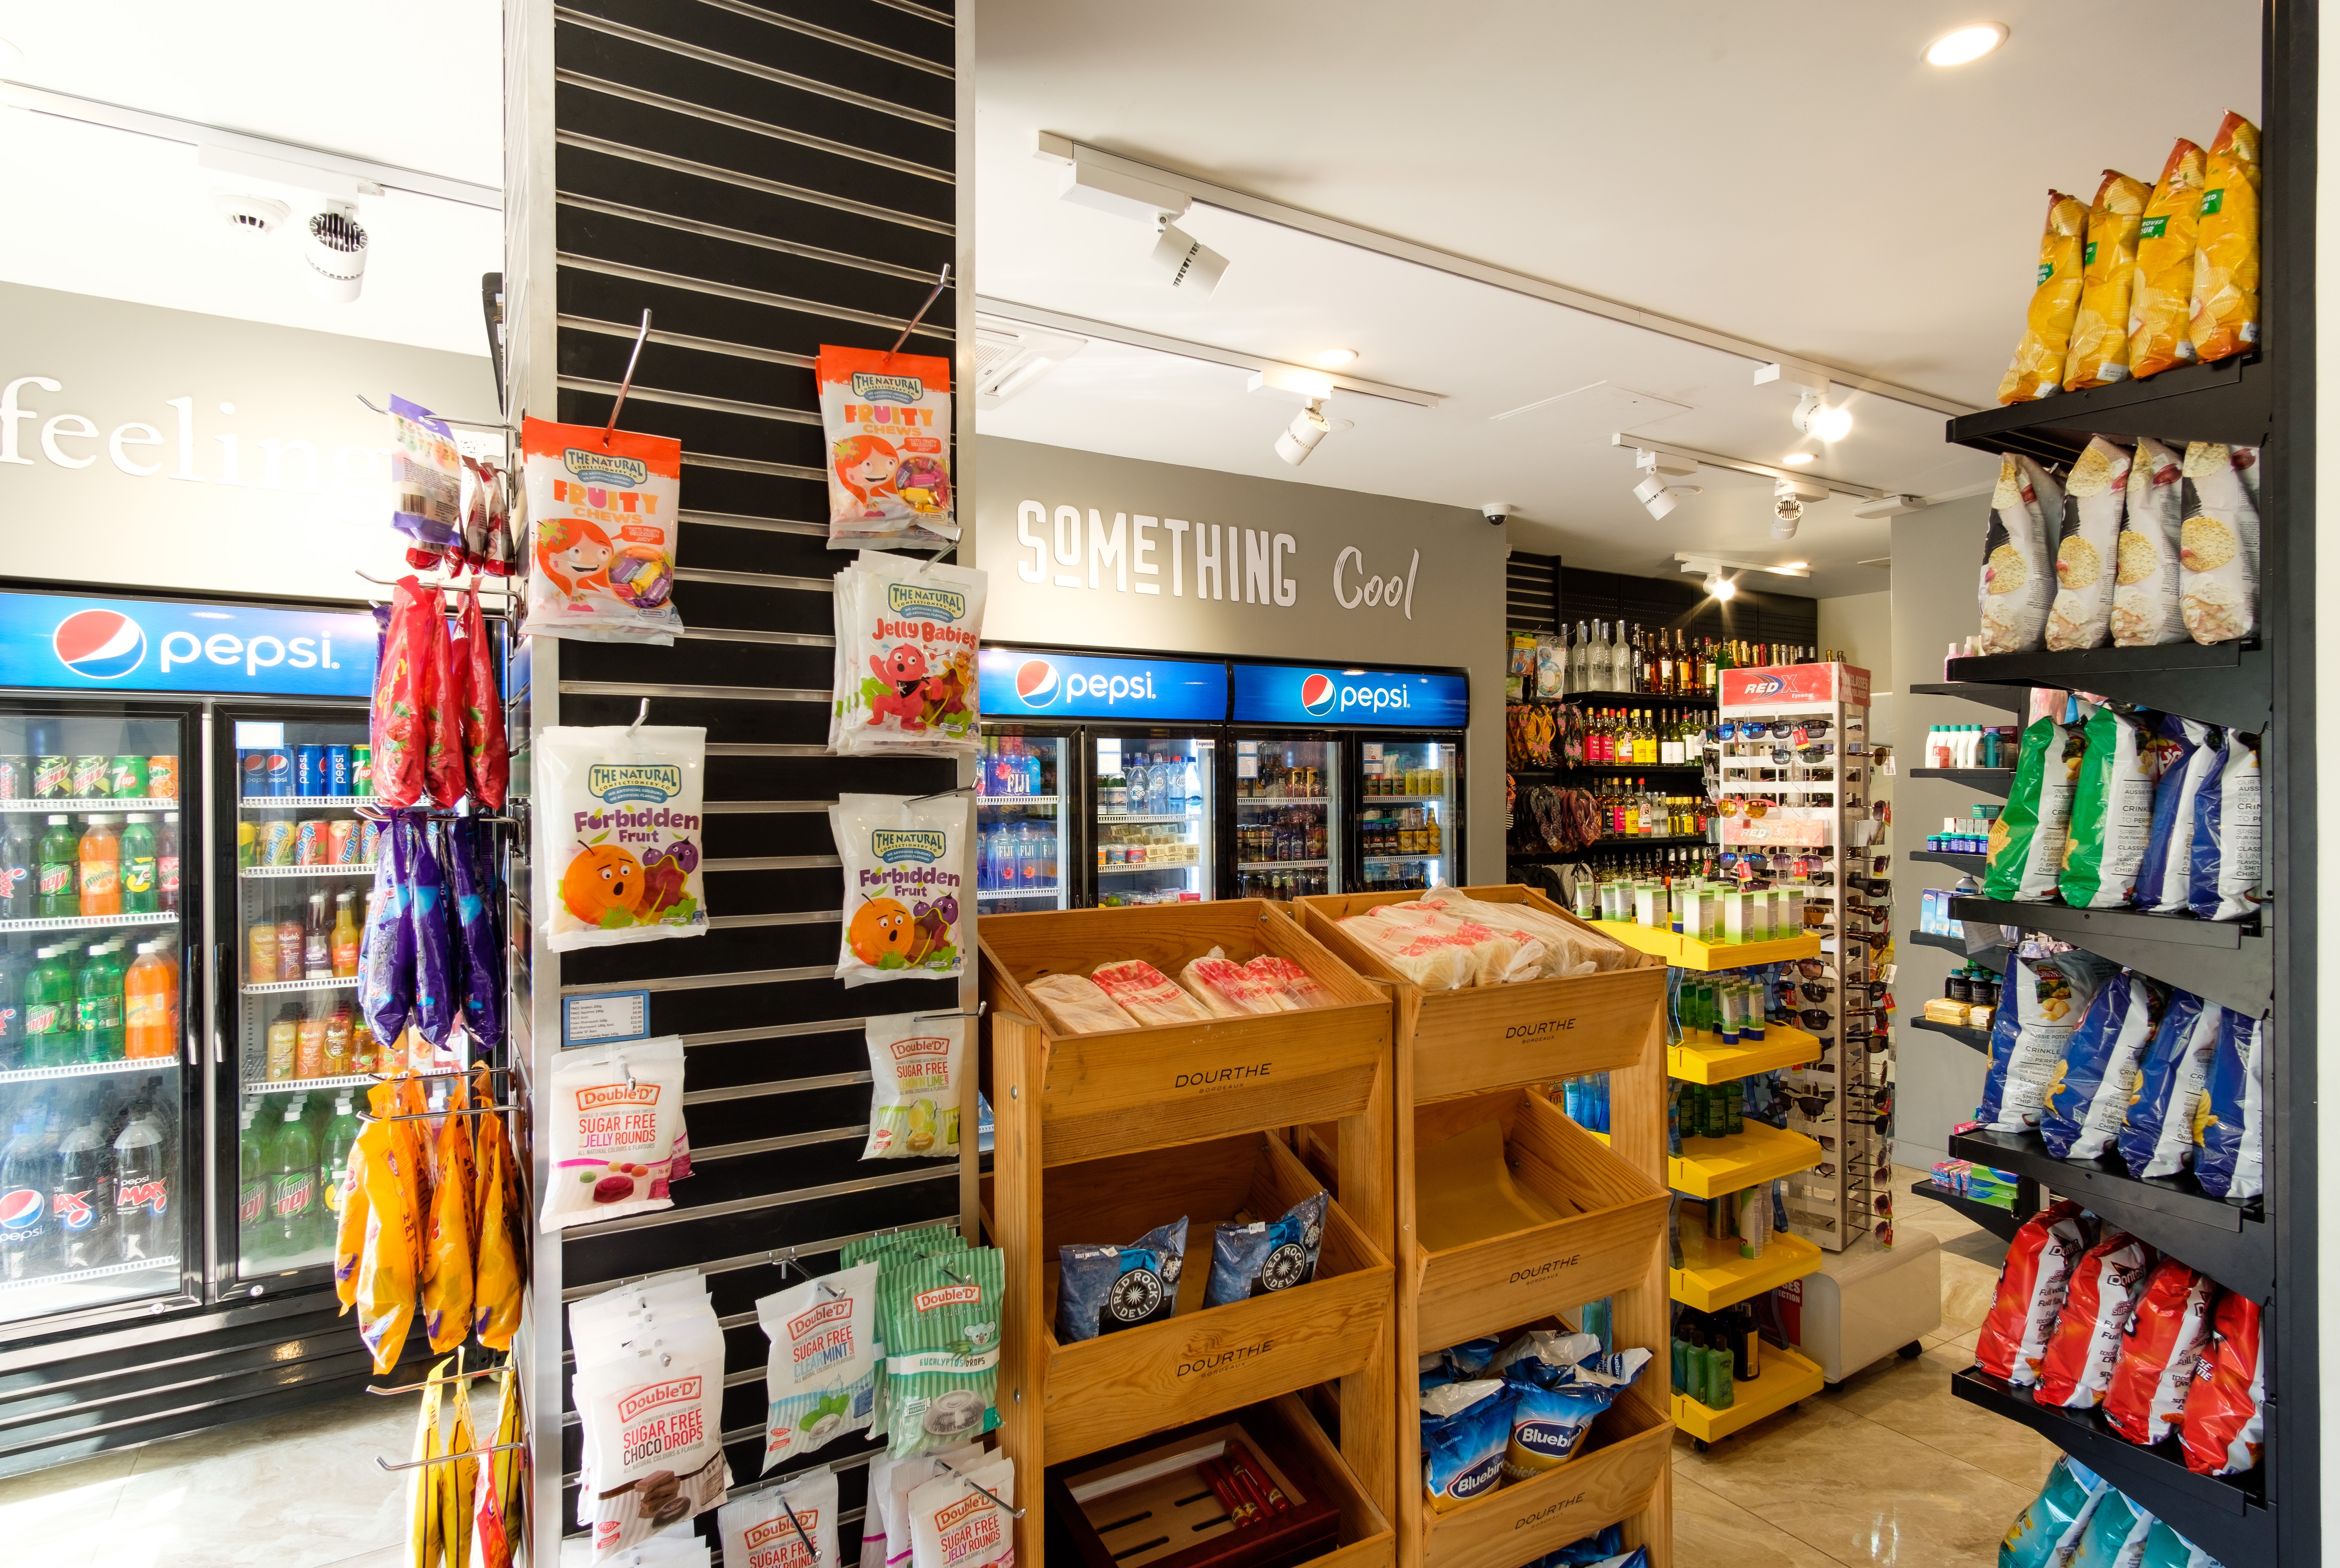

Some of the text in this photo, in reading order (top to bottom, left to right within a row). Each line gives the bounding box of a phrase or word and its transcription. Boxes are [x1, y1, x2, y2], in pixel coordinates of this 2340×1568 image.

[856, 375, 919, 393] THE NATURAL
[844, 404, 934, 426] FRUITY
[863, 423, 922, 436] CHEWS
[0, 376, 392, 524] feeling
[568, 452, 643, 476] THE NATURAL
[554, 479, 659, 515] FRUITY
[573, 507, 643, 524] CHEWS
[1018, 500, 1419, 620] SOMETHING Cool
[872, 618, 976, 650] Jelly Babies
[160, 631, 331, 676] pepsi
[1067, 671, 1152, 704] pepsi
[1744, 682, 1778, 694] RED
[1341, 684, 1408, 713] pepsi
[299, 755, 309, 784] pepsi
[336, 754, 346, 783] pepsi
[594, 769, 677, 786] THE NATURAL
[1007, 774, 1030, 793] FIJI
[574, 808, 699, 832] Forbidden
[619, 829, 659, 842] Fruit
[999, 846, 1013, 857] FIJI
[1020, 845, 1034, 856] FIJI
[860, 867, 960, 887] Forbidden
[894, 886, 927, 897] Fruit
[328, 1029, 347, 1037] Noah's
[1505, 1018, 1576, 1039] DOURTHE
[2026, 1046, 2061, 1054] CRINKLE
[1175, 1063, 1272, 1088] DOURTHE
[2019, 1077, 2046, 1086] CLASSIC
[1199, 1083, 1244, 1094] BORDEAUX
[579, 1114, 656, 1134] SUGAR FREE
[584, 1130, 655, 1147] JELLY ROUNDS
[118, 1177, 167, 1205] MAX
[2050, 1239, 2081, 1256] Doritos
[1266, 1247, 1303, 1276] RED ROCK
[1509, 1254, 1580, 1284] DOURTHE
[1270, 1274, 1295, 1288] DELI
[2108, 1265, 2144, 1285] Doritos
[1114, 1273, 1157, 1305] RED ROCK
[1778, 1289, 1800, 1303] ECTION
[912, 1314, 941, 1326] pioneering
[944, 1308, 969, 1318] healthier
[1120, 1304, 1150, 1319] DELI
[794, 1325, 853, 1363] SUGAR FREE
[2101, 1331, 2119, 1339] Full
[966, 1357, 985, 1367] DROPS
[1177, 1340, 1274, 1377] DOURTHE
[1201, 1362, 1246, 1378] BORDEAUX
[642, 1413, 665, 1425] PIONEERING
[666, 1408, 686, 1417] HEALTHIER
[624, 1408, 702, 1449] SUGAR FREE
[624, 1425, 703, 1465] CHOCO DROPS
[633, 1459, 652, 1470] NATURAL
[653, 1451, 675, 1461] COLOURS
[681, 1441, 704, 1453] FLAVOURS
[1515, 1492, 1585, 1530] DOURTHE
[948, 1529, 1000, 1563] JELLY ROUNDS
